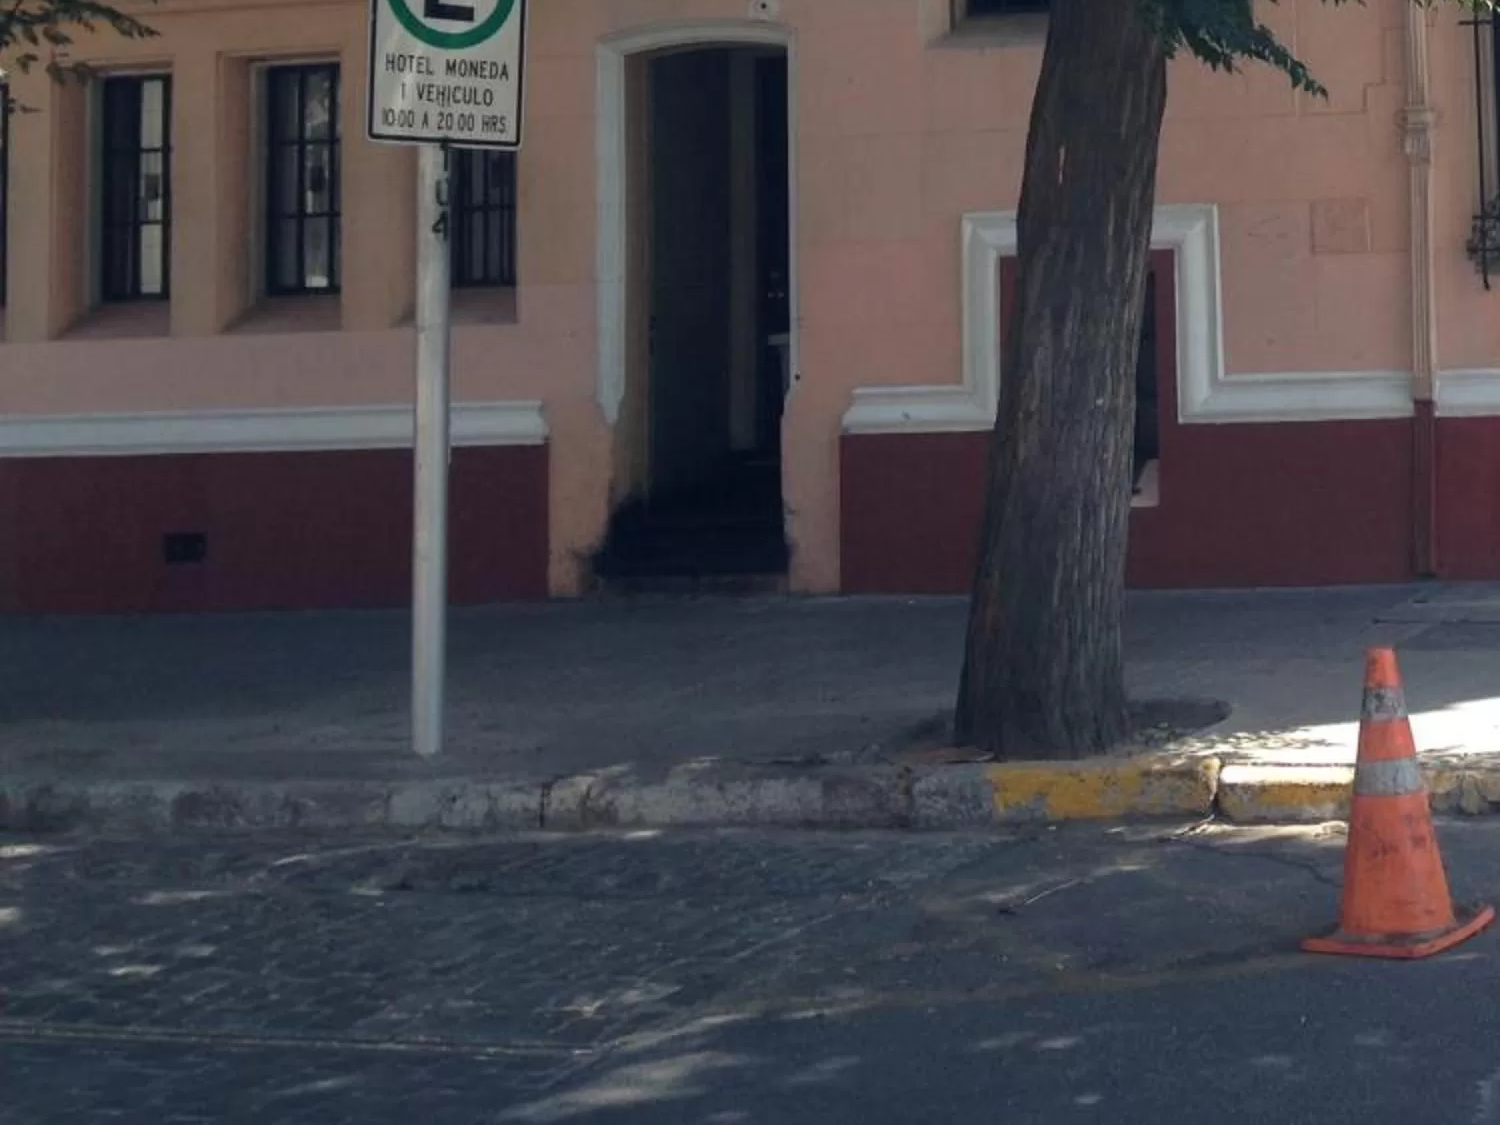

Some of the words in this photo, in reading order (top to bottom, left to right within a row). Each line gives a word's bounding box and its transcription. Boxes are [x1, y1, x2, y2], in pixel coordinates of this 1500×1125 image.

[385, 53, 435, 76] HOTEL
[445, 58, 509, 81] MONEDA
[416, 82, 494, 108] VEHICULO
[422, 110, 429, 130] A
